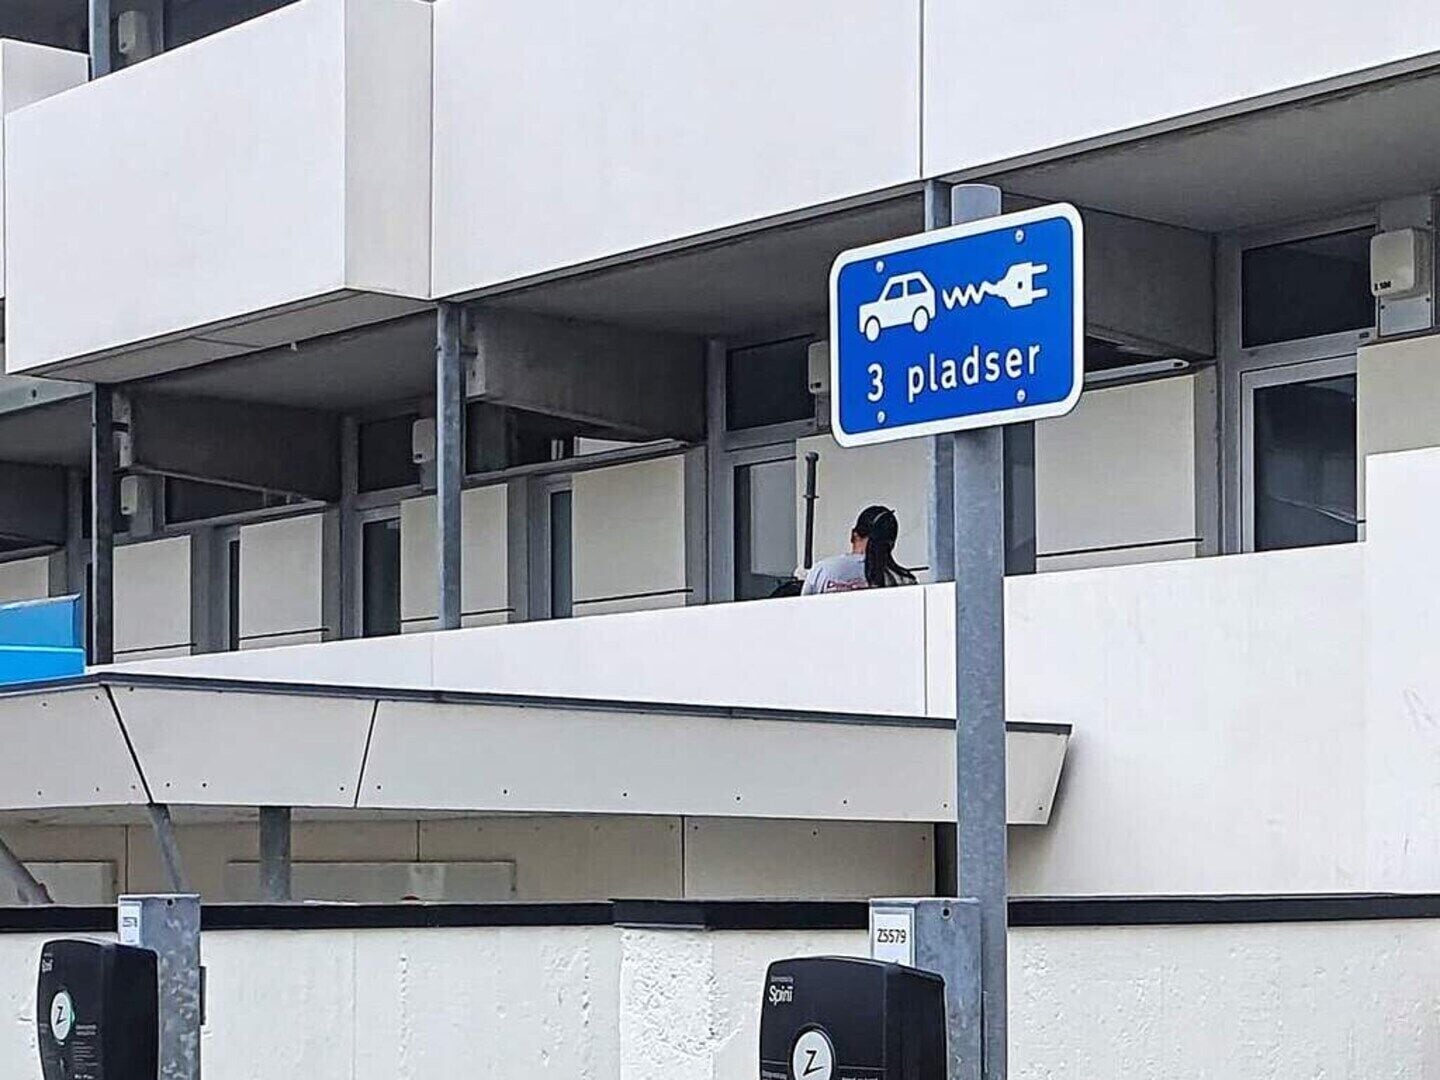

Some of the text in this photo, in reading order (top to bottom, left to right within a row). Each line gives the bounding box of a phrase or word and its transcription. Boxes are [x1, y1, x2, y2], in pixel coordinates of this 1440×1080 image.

[867, 344, 1041, 404] 3 pladser
[877, 927, 907, 944] Z5579
